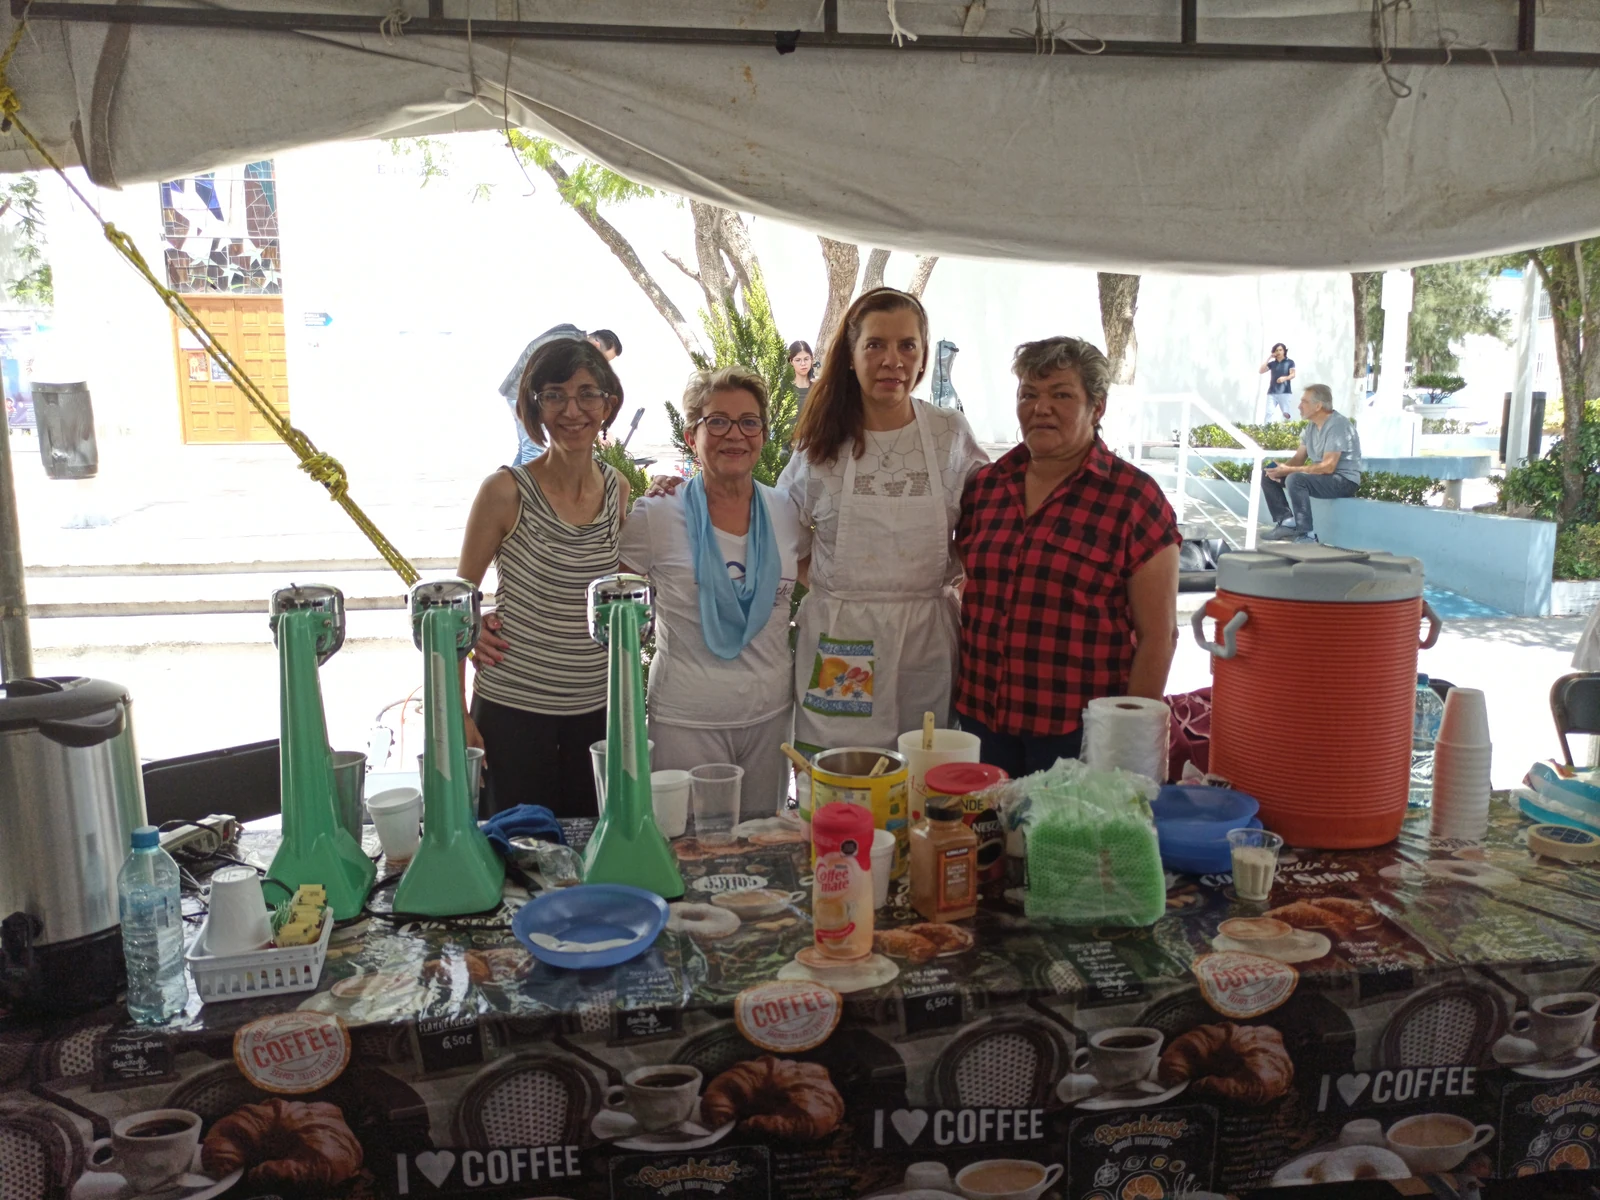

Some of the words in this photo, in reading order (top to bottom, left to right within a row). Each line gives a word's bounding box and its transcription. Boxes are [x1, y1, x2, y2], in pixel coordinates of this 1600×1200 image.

[816, 863, 848, 884] Coffee
[821, 879, 849, 893] mate
[1212, 961, 1285, 993] COFFEE
[751, 991, 831, 1028] COFFEE
[252, 1023, 339, 1069] COFFEE
[1317, 1075, 1331, 1113] I
[1372, 1067, 1477, 1104] COFFEE
[1531, 1080, 1600, 1116] Breakfa
[873, 1109, 884, 1149] I
[933, 1108, 1044, 1146] COFFEE
[1094, 1114, 1188, 1145] Breakfast
[1134, 1136, 1170, 1149] morning
[395, 1153, 408, 1194] I
[461, 1145, 582, 1187] COFFEE
[638, 1158, 741, 1187] Breakfast
